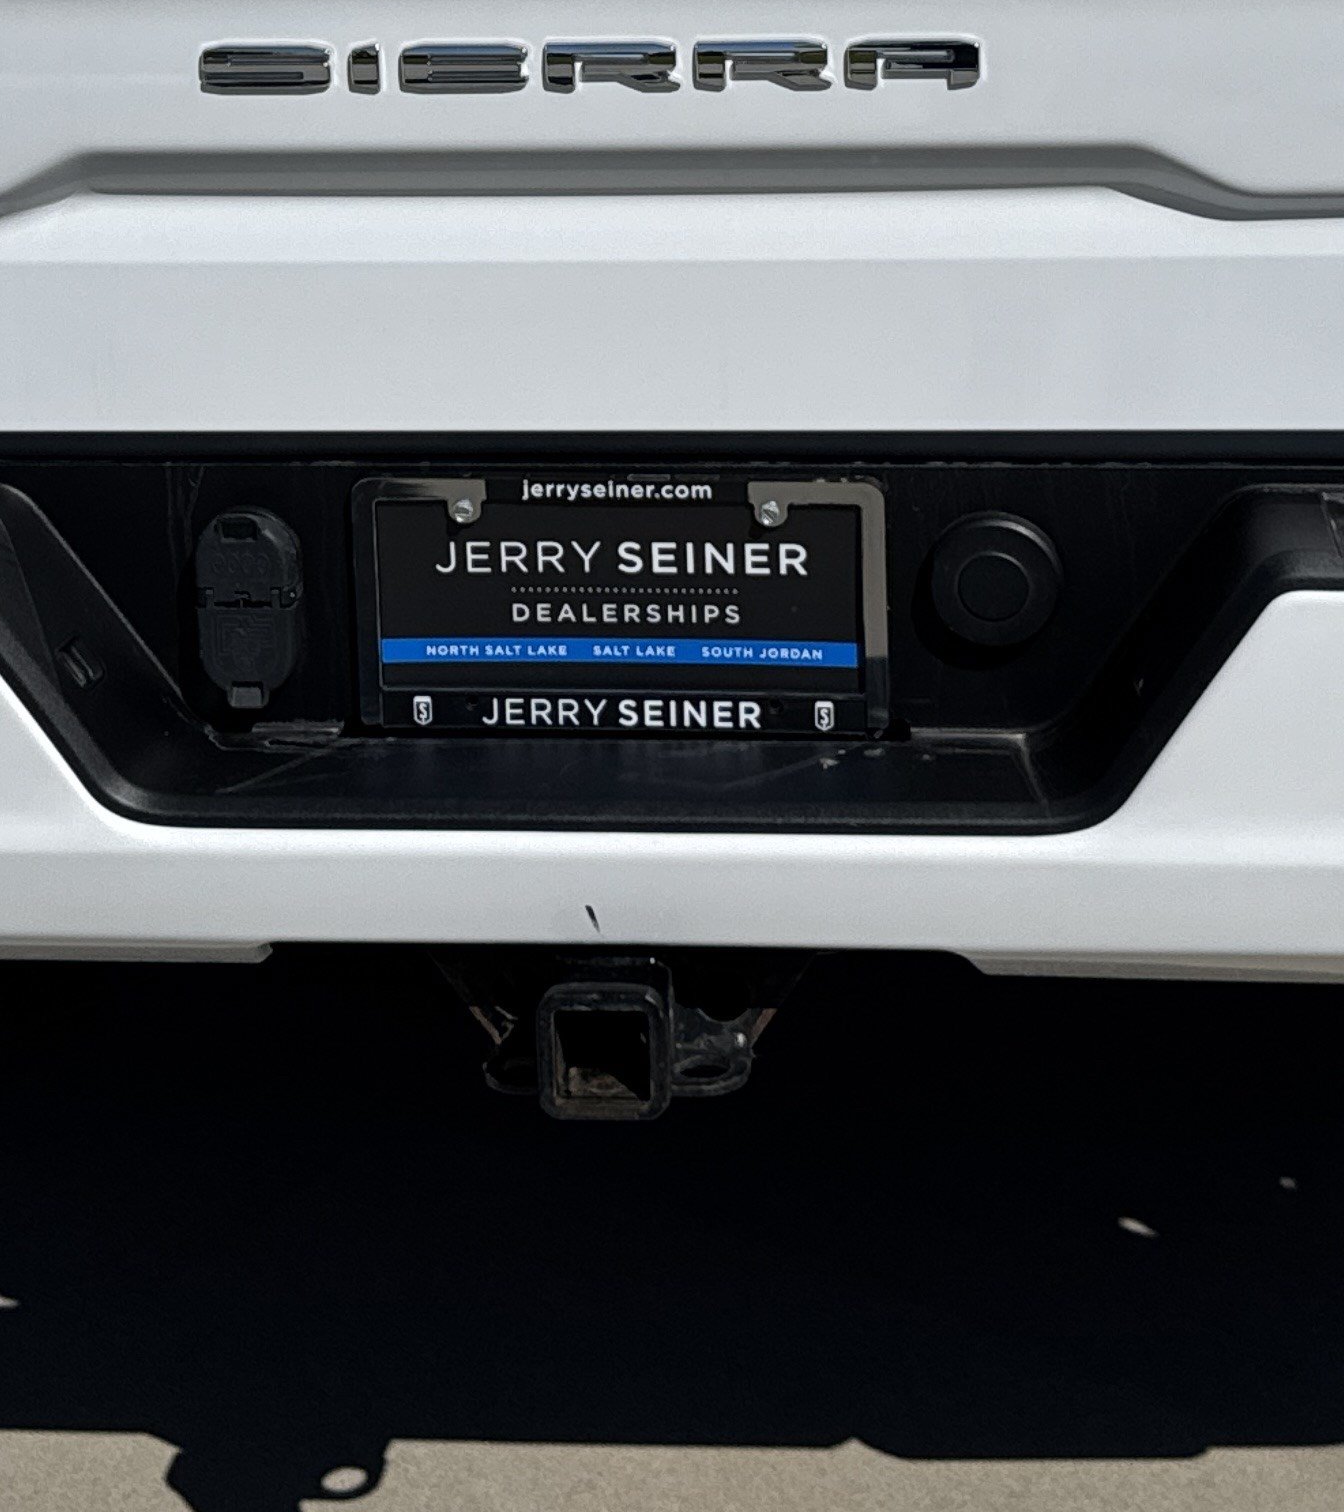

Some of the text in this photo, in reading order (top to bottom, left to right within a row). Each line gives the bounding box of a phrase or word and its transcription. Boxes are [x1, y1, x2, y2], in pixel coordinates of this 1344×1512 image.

[199, 39, 982, 94] SIERRA
[522, 478, 712, 501] jerryseiner.com
[435, 540, 808, 577] JERRY SEINER
[512, 603, 740, 624] DEALERSHIPS
[426, 644, 823, 661] NORTH SALT LAKE SALT LAKE SOUTH JORDAN
[482, 698, 761, 729] JERRY SEINER
